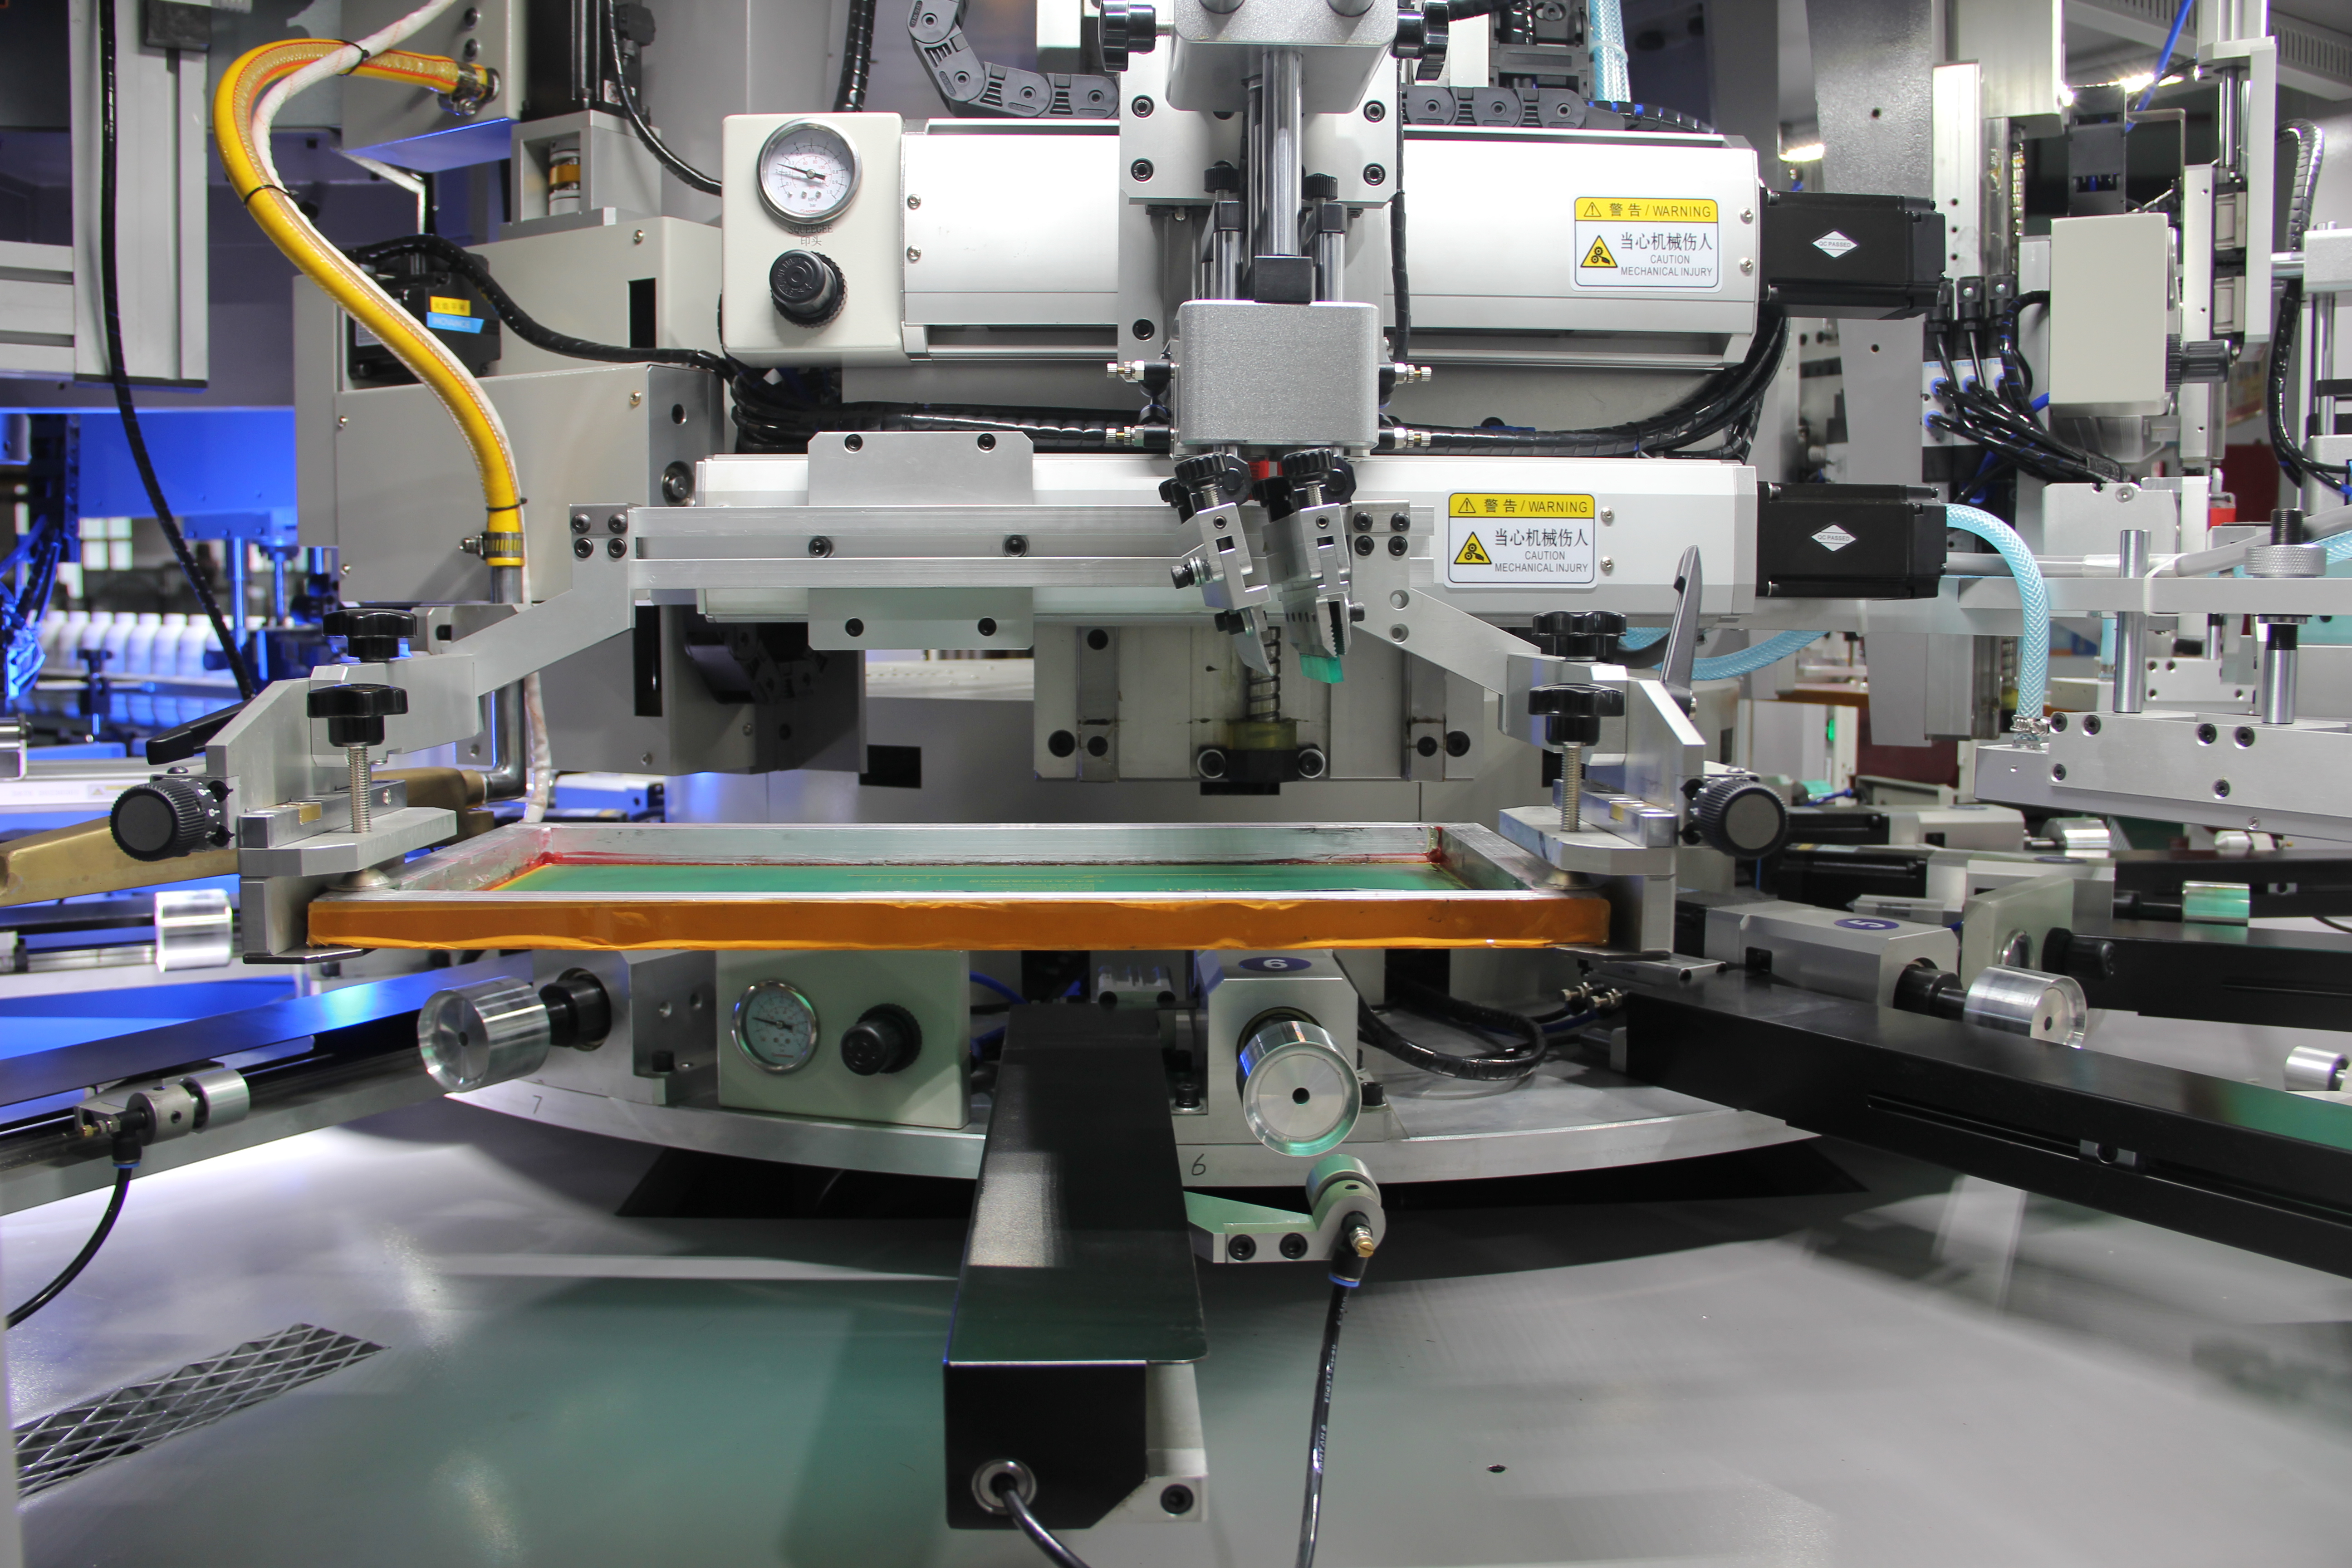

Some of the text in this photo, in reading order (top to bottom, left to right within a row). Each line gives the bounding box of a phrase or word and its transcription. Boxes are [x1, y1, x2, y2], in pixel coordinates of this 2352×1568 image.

[1609, 203, 1642, 217] 警告
[1653, 206, 1711, 217] WARNING
[789, 224, 833, 234] SQUEEGEE
[800, 235, 822, 246] 印头
[1621, 232, 1712, 251] 当心机械伤人
[1650, 255, 1690, 264] CAUTION
[1621, 266, 1713, 277] MECHANICAL INJURY
[1484, 499, 1517, 513] 警告
[1528, 501, 1588, 513] WARNING
[1495, 528, 1588, 547] 当心机械伤人
[1525, 551, 1565, 560] CAUTION
[1495, 563, 1588, 572] MECHANICAL INJURY
[1847, 920, 1886, 928] 5
[1263, 959, 1288, 969] 6
[533, 1094, 543, 1114] 7
[1191, 1153, 1206, 1176] 6
